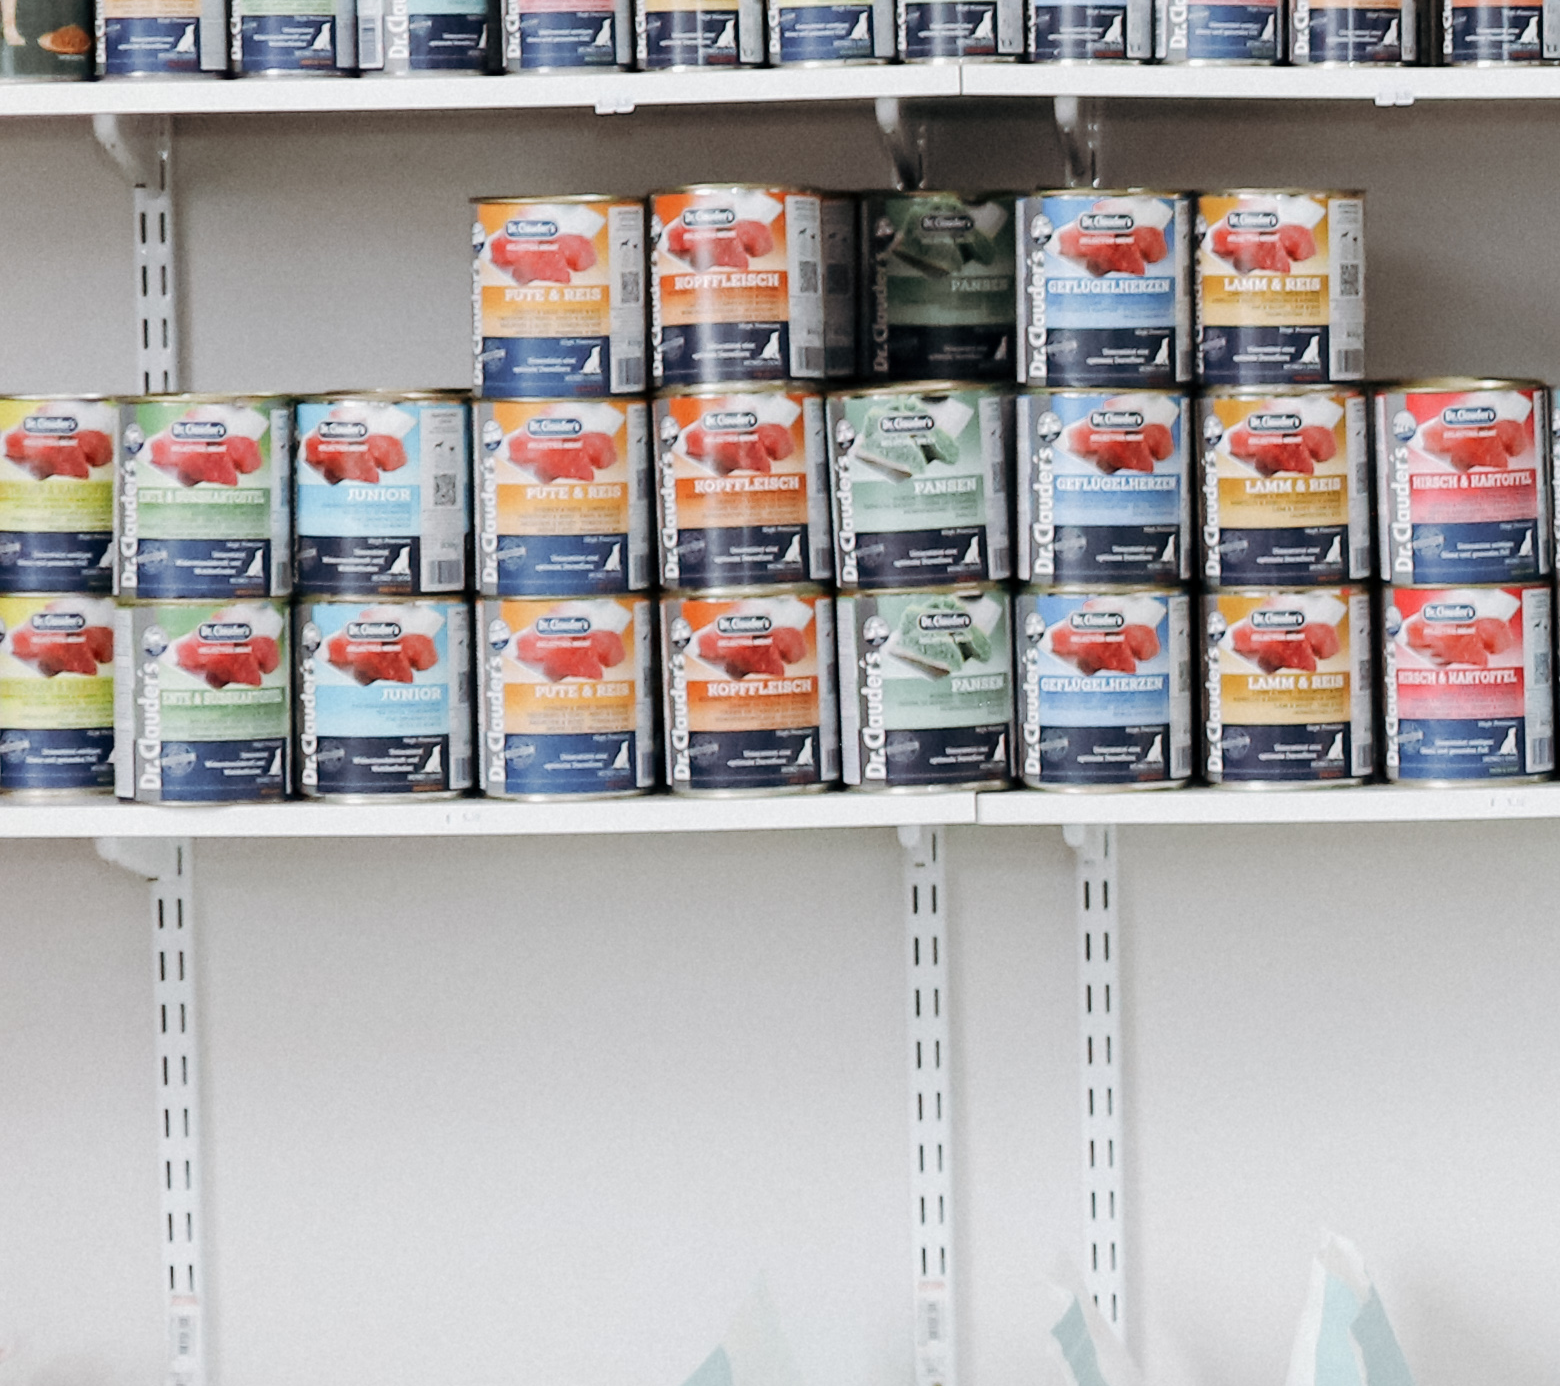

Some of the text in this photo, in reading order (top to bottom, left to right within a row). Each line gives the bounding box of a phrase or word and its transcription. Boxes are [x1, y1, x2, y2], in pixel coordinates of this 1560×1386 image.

[674, 274, 779, 288] KOPFFLEISCH
[1047, 278, 1171, 294] GEFLÜGELHERZEN
[1224, 278, 1266, 292] LAMM
[1285, 278, 1321, 292] REIS
[913, 478, 977, 493] PANSEN
[1413, 474, 1457, 488] HIRSCH
[347, 488, 410, 503] JUNIOR
